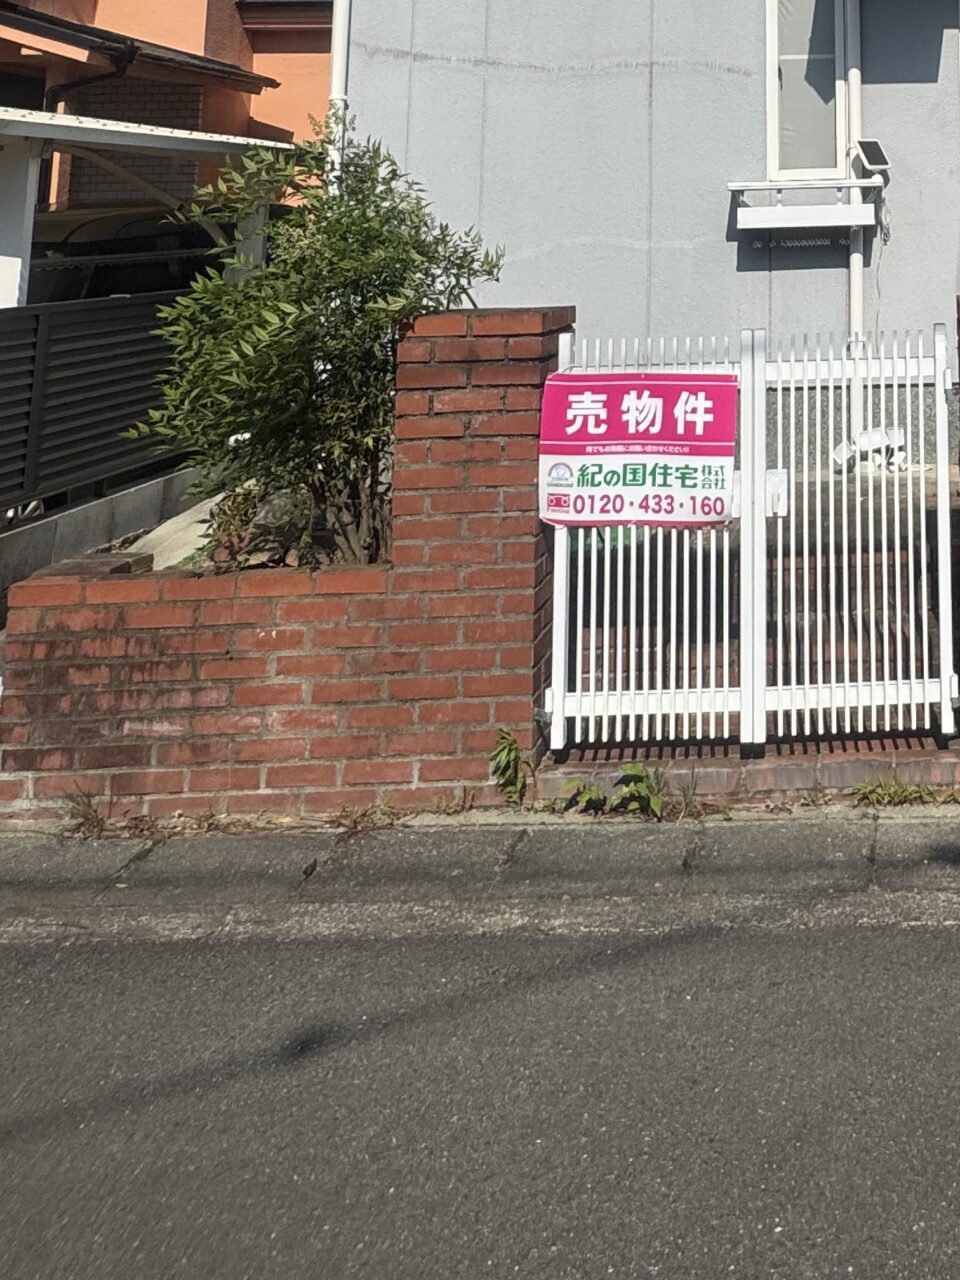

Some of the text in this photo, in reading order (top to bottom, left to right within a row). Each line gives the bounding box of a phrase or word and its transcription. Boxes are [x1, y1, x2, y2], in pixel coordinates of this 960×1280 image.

[565, 390, 714, 435] 売物件
[577, 463, 698, 489] 紀の国住宅
[701, 464, 726, 476] 株式
[701, 477, 726, 490] 会社
